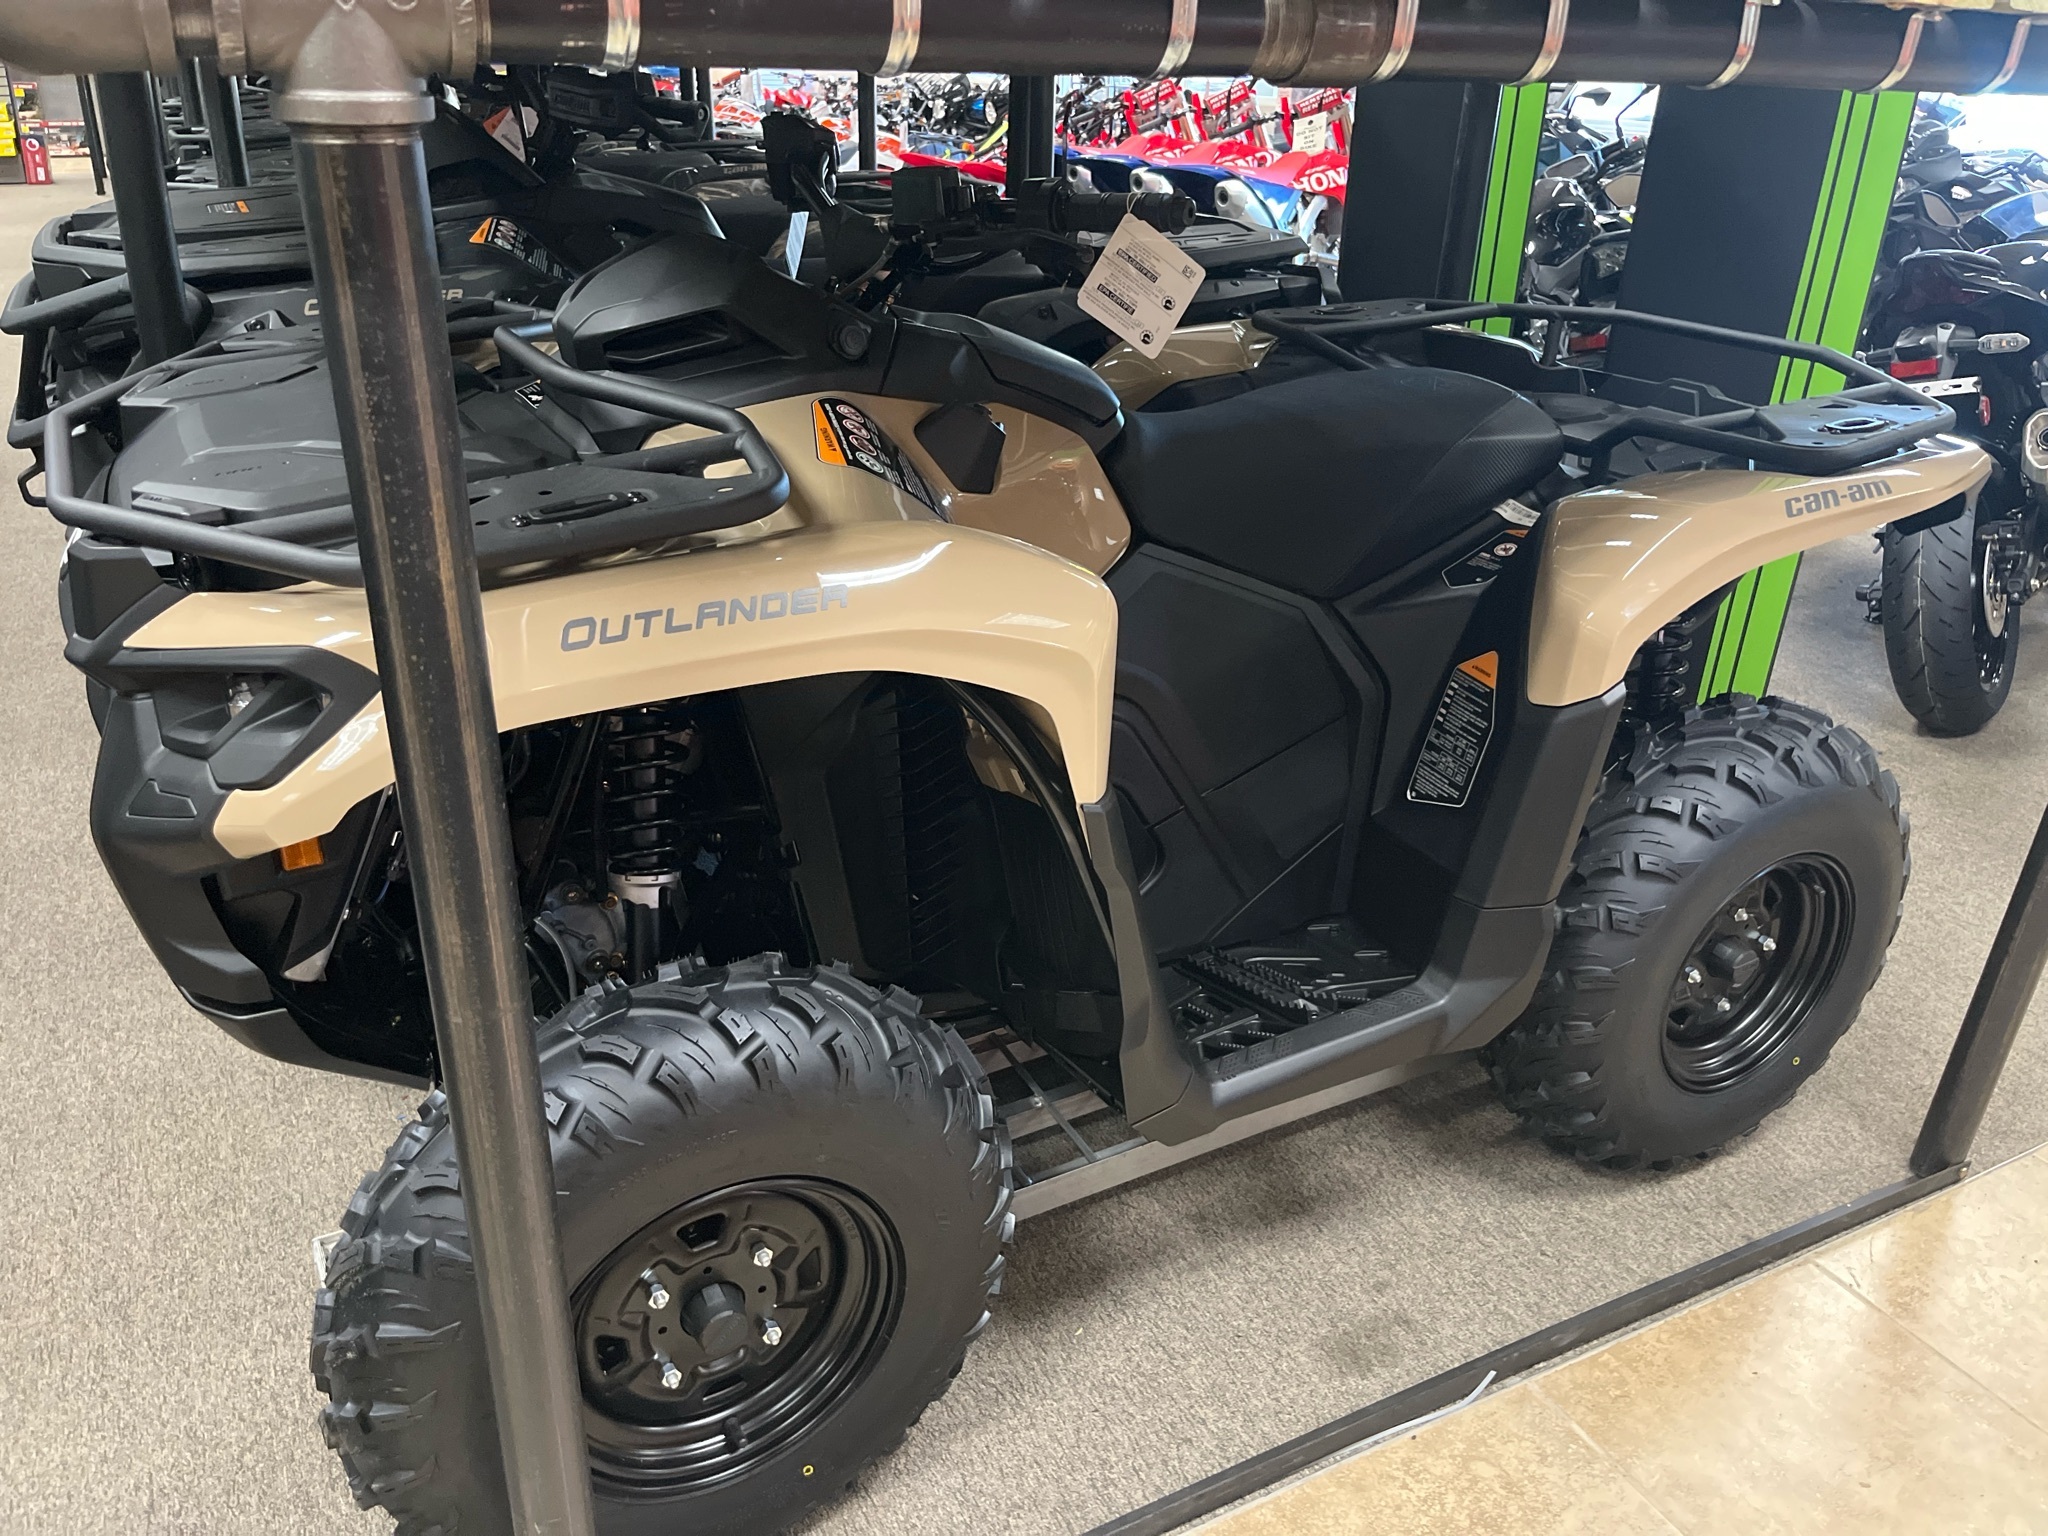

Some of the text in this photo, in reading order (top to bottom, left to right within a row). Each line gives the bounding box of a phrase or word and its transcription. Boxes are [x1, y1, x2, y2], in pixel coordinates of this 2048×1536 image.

[1141, 87, 1172, 105] RENHAL
[1212, 89, 1245, 109] RENHAL
[1302, 94, 1338, 113] RENHAL
[1291, 166, 1348, 192] HON
[1130, 258, 1158, 282] CERTIFIED
[820, 427, 833, 451] WARNING
[1784, 480, 1893, 518] can-am
[560, 584, 849, 652] OUTLANDER
